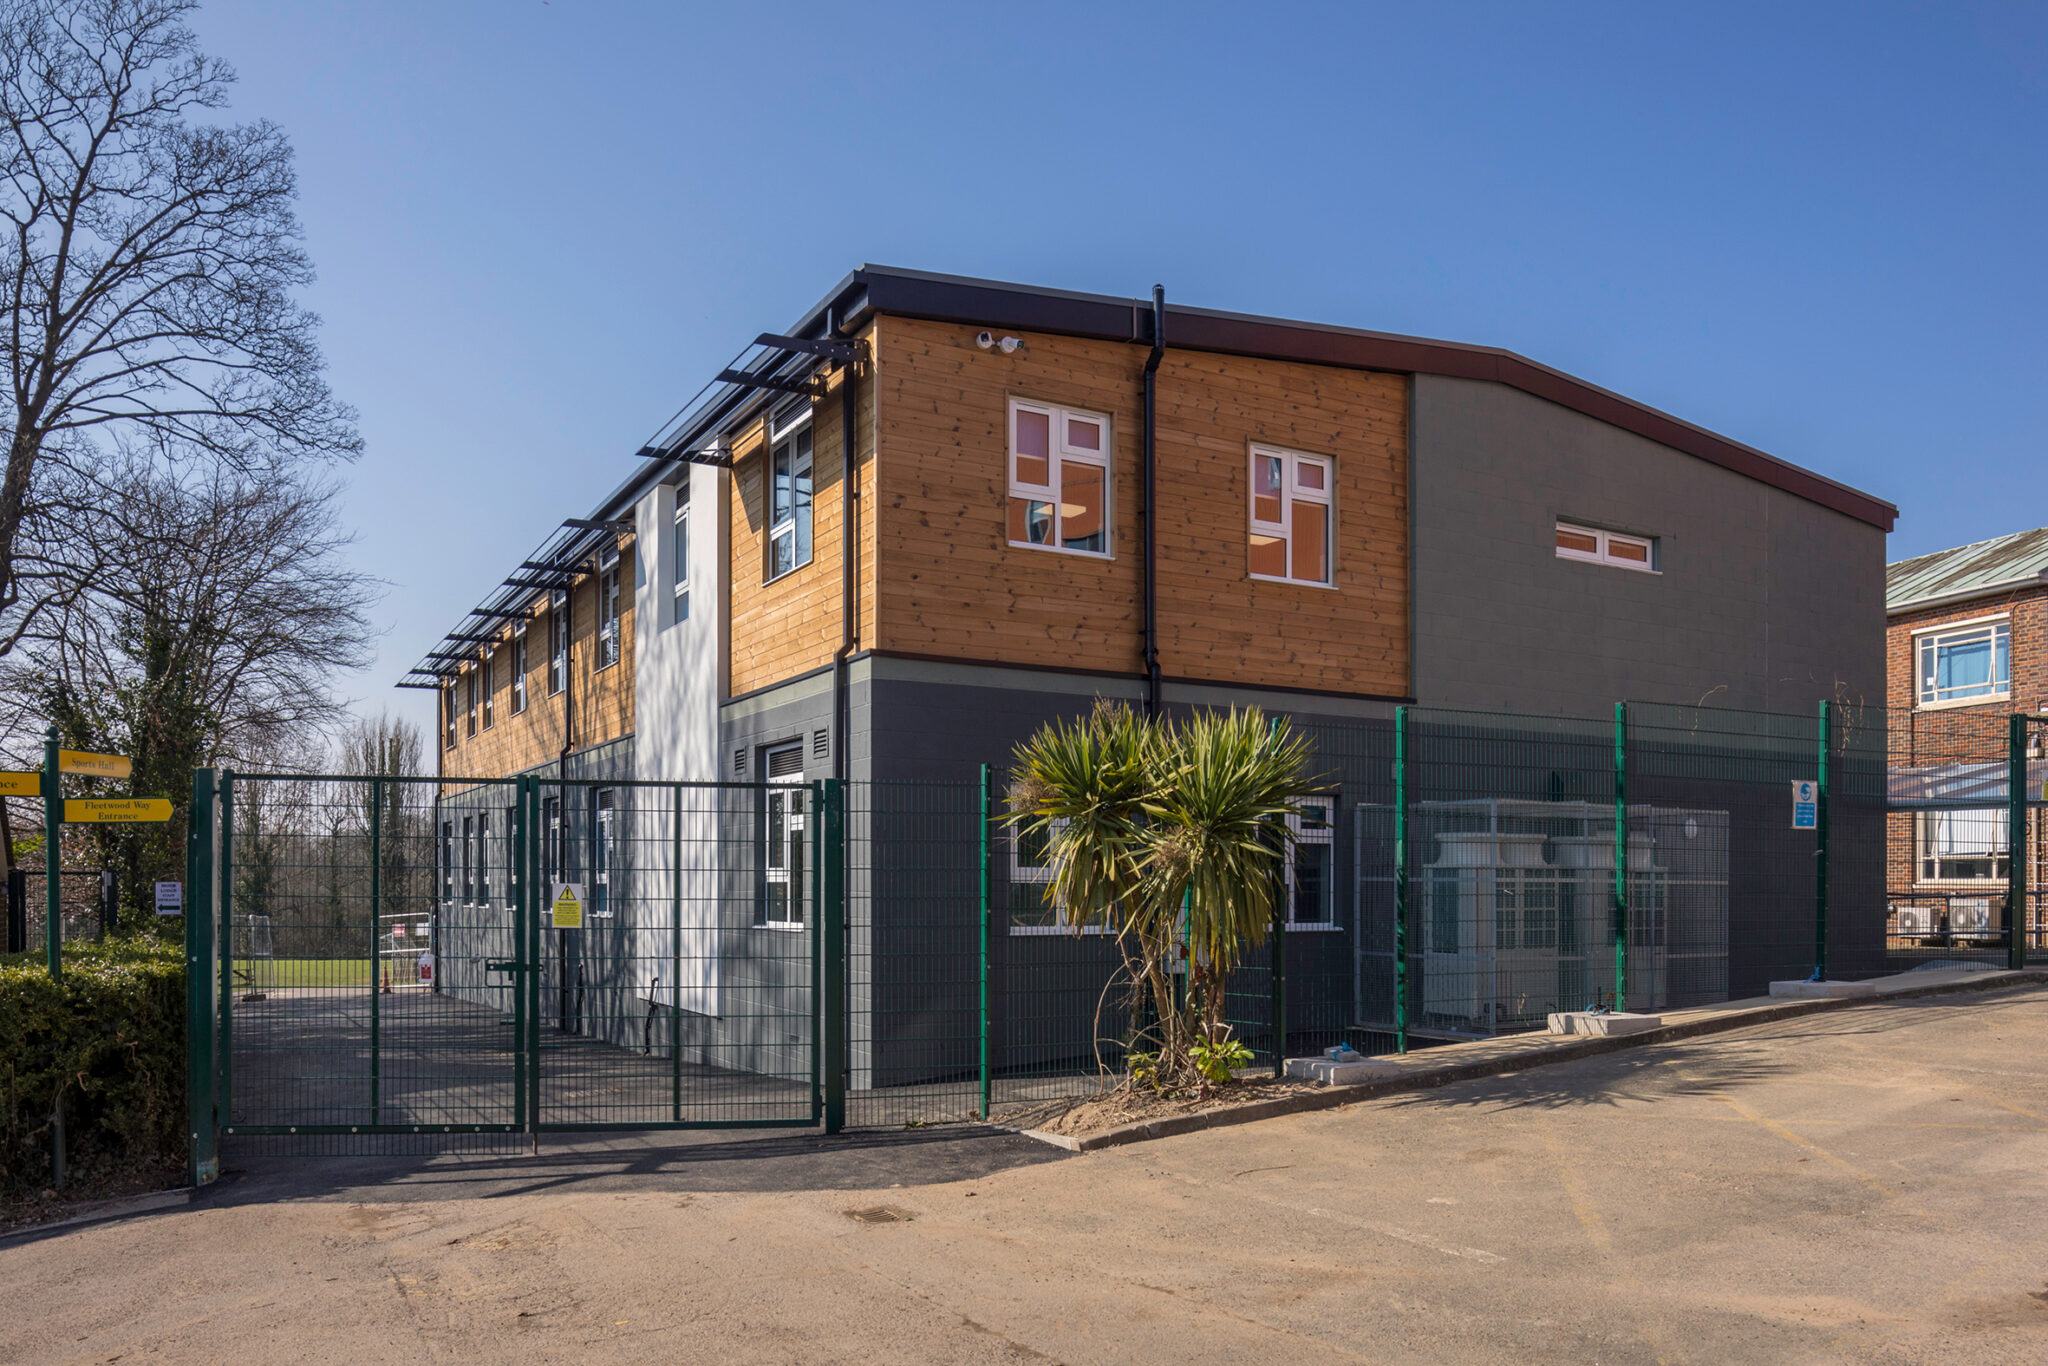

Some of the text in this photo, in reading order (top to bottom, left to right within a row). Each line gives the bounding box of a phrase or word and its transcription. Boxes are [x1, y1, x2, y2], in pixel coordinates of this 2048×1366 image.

[98, 759, 114, 770] Hall
[84, 801, 151, 810] Fleetwood Way
[98, 812, 138, 820] Entrance
